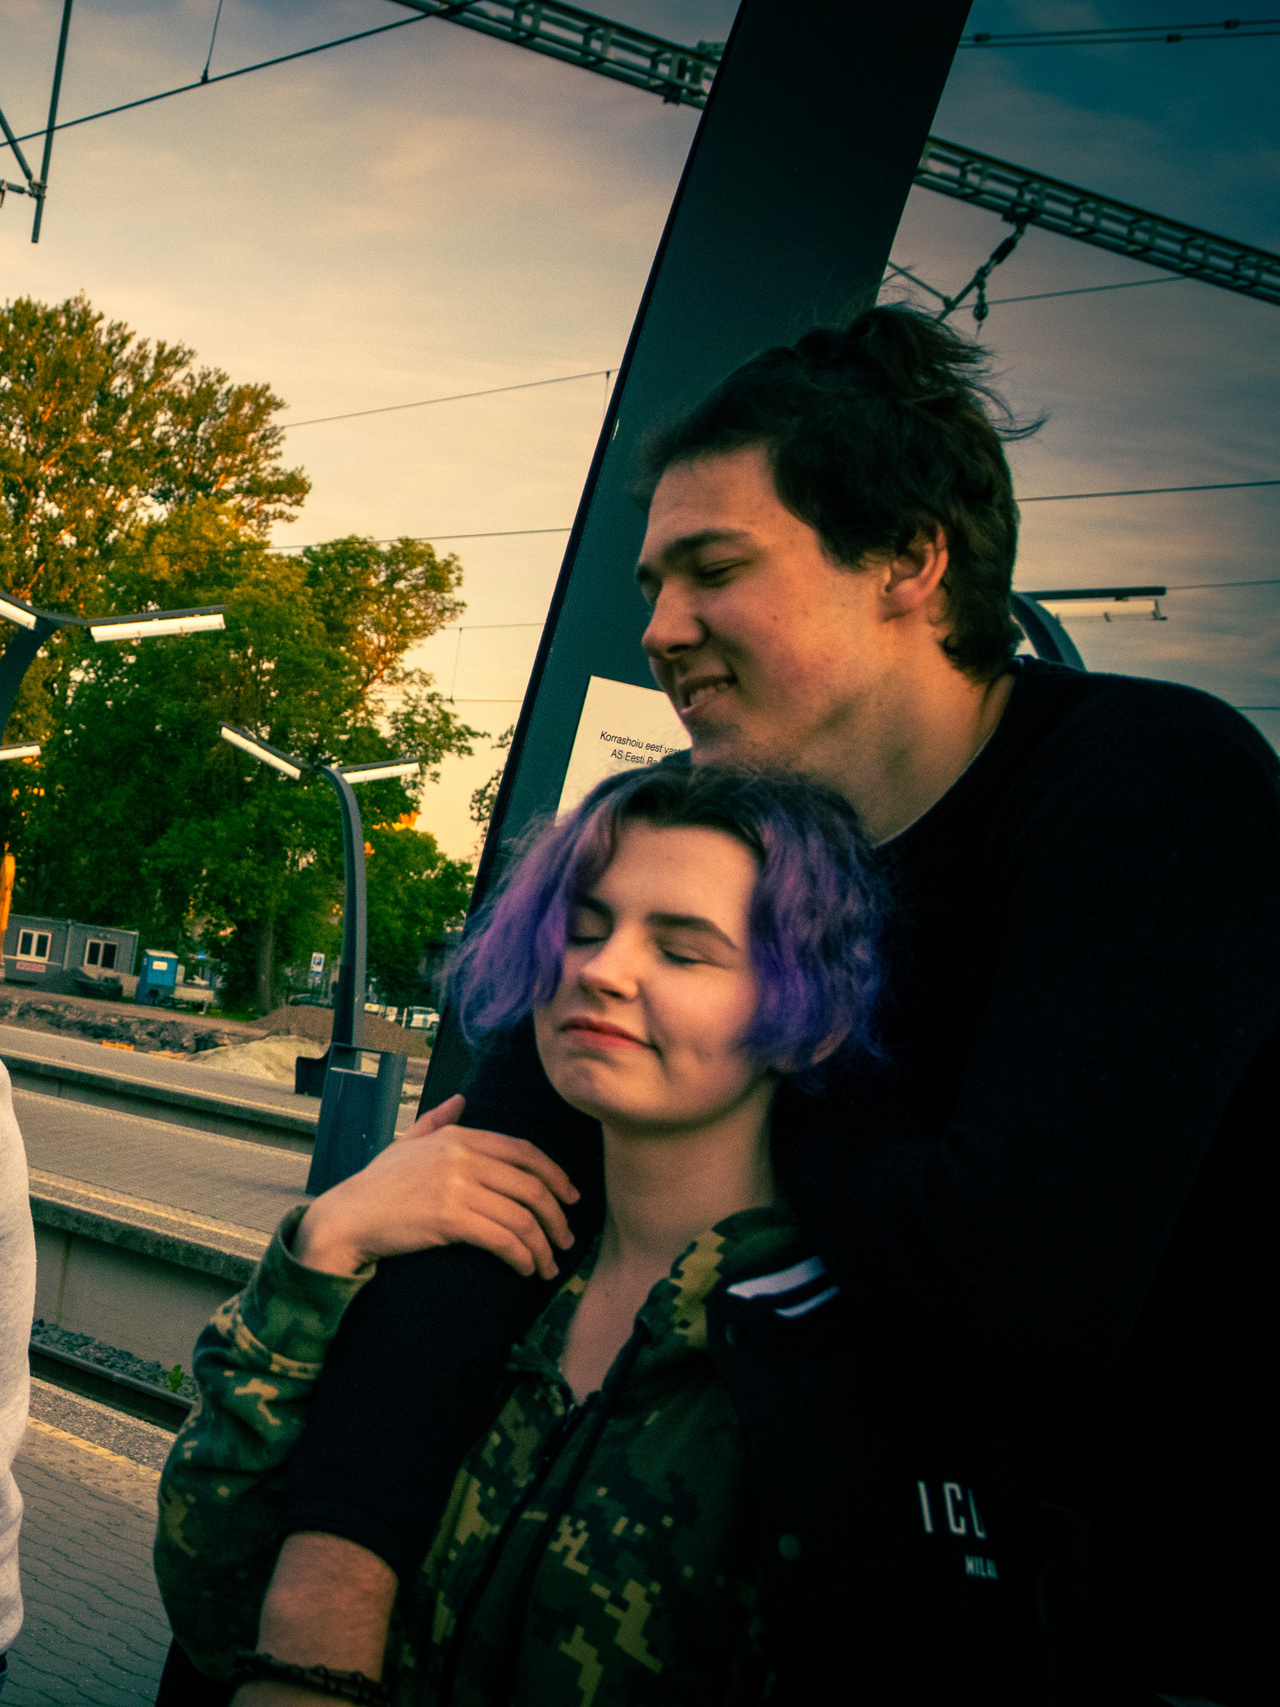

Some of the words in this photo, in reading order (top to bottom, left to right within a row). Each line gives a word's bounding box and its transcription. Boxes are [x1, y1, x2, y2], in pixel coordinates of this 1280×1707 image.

[600, 731, 644, 749] Korrashoiu
[645, 743, 663, 753] eest
[610, 749, 624, 760] AS
[624, 751, 646, 764] Eesti
[646, 756, 658, 766] Ra
